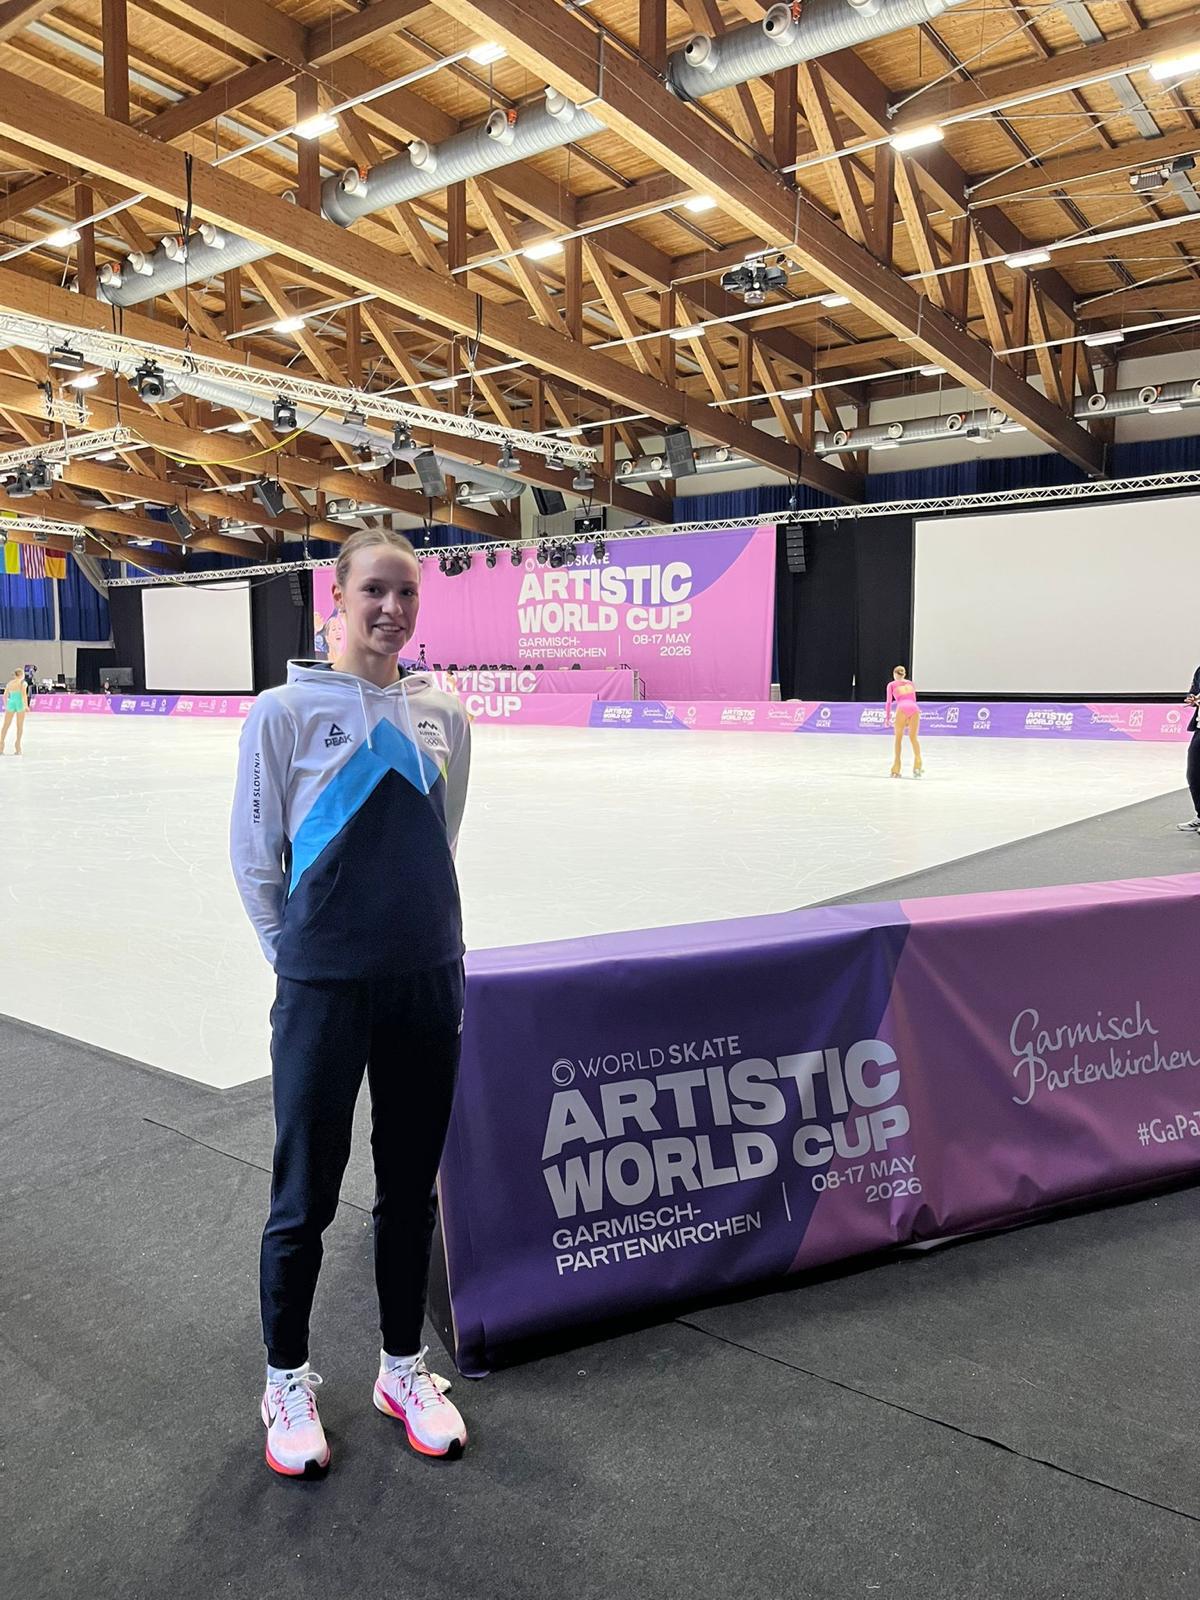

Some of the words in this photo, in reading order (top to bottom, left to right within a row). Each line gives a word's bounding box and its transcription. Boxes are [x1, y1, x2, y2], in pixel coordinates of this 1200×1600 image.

[517, 562, 692, 606] ARTISTIC
[517, 602, 618, 634] WORLD
[626, 603, 692, 631] CUP
[518, 636, 581, 648] GARMISCH-
[519, 648, 607, 659] PARTENKIRCHEN
[632, 634, 662, 645] 08-17
[665, 633, 692, 644] MAY
[660, 646, 692, 657] 2026
[466, 694, 522, 717] CUP
[1026, 712, 1074, 721] ARTISTIC
[324, 734, 353, 748] PEAK
[1009, 1001, 1159, 1062] Garmisch
[578, 1047, 665, 1079] WORLD
[669, 1035, 742, 1065] SKATE
[1012, 1040, 1200, 1105] Partenkirchen
[541, 1039, 901, 1161] ARTISTIC
[542, 1131, 779, 1219] WORLD
[792, 1104, 911, 1168] CUP
[811, 1167, 864, 1193] 08-17
[870, 1155, 918, 1180] MAY
[865, 1177, 923, 1203] 2026
[552, 1202, 701, 1250] GARMISCH-
[555, 1211, 762, 1276] PARTENKIRCHEN
